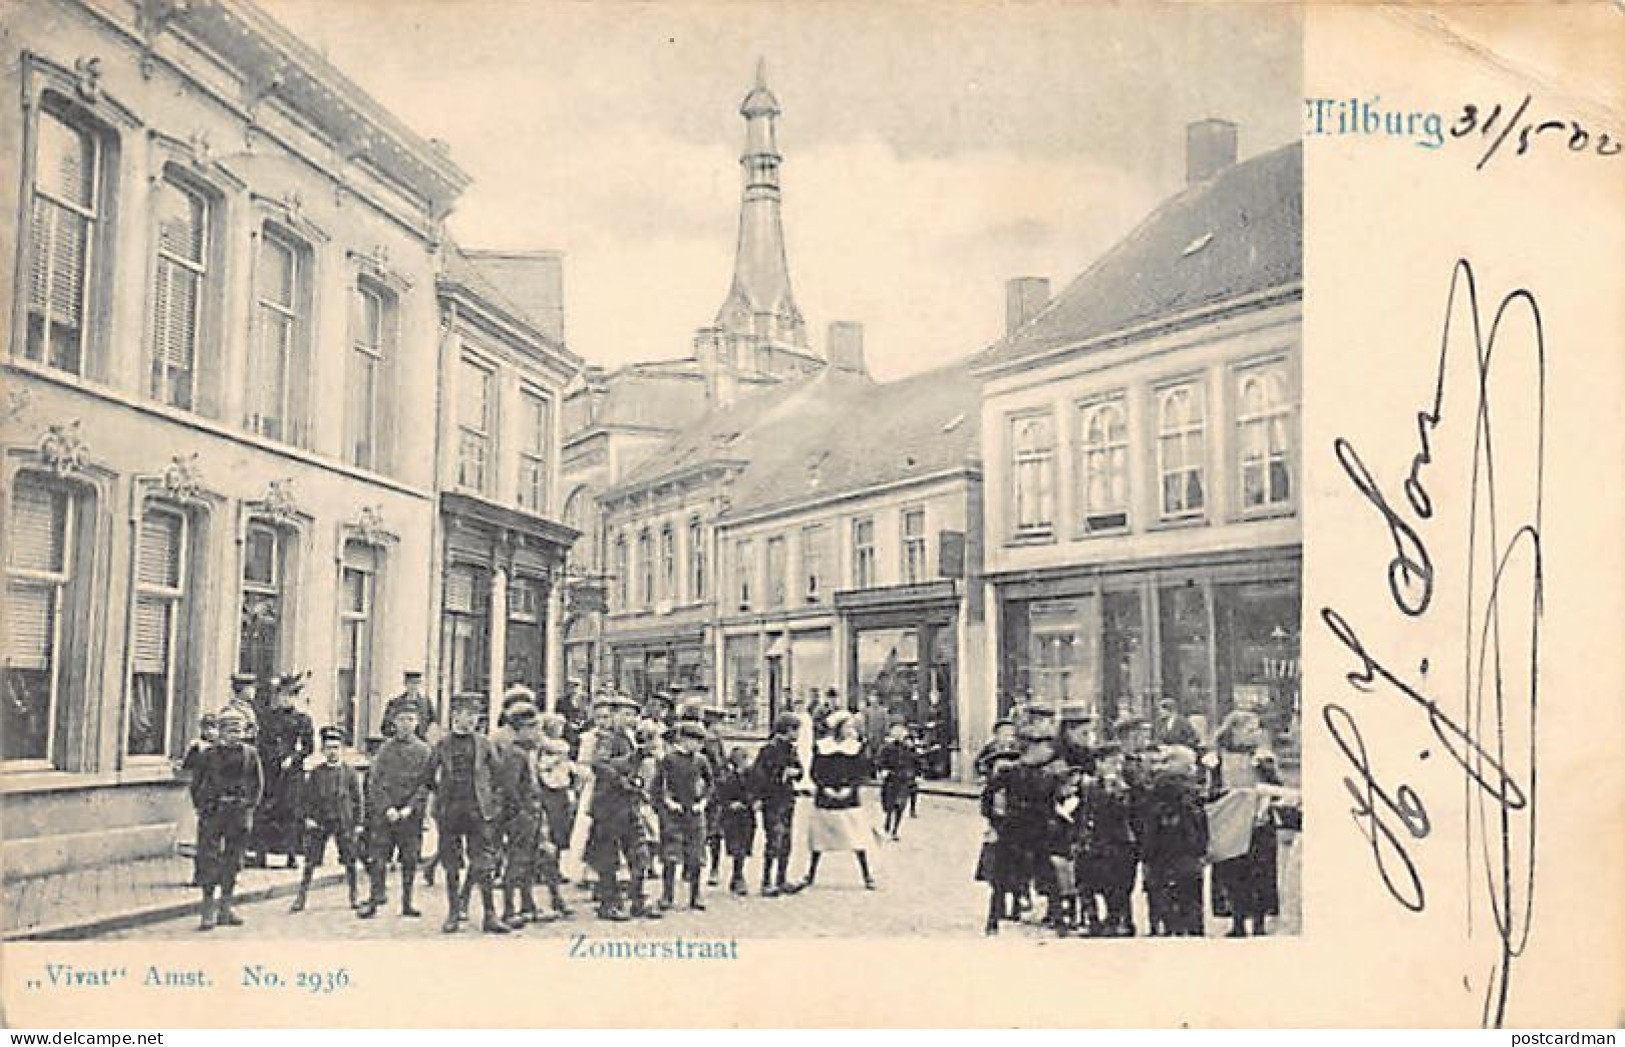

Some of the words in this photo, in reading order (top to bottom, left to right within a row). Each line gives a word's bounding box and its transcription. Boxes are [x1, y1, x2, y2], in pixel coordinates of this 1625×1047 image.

[1303, 95, 1445, 149] Tilburg
[569, 932, 740, 960] Zomerstraat
[143, 965, 215, 988] Amst.
[240, 964, 287, 988] No.
